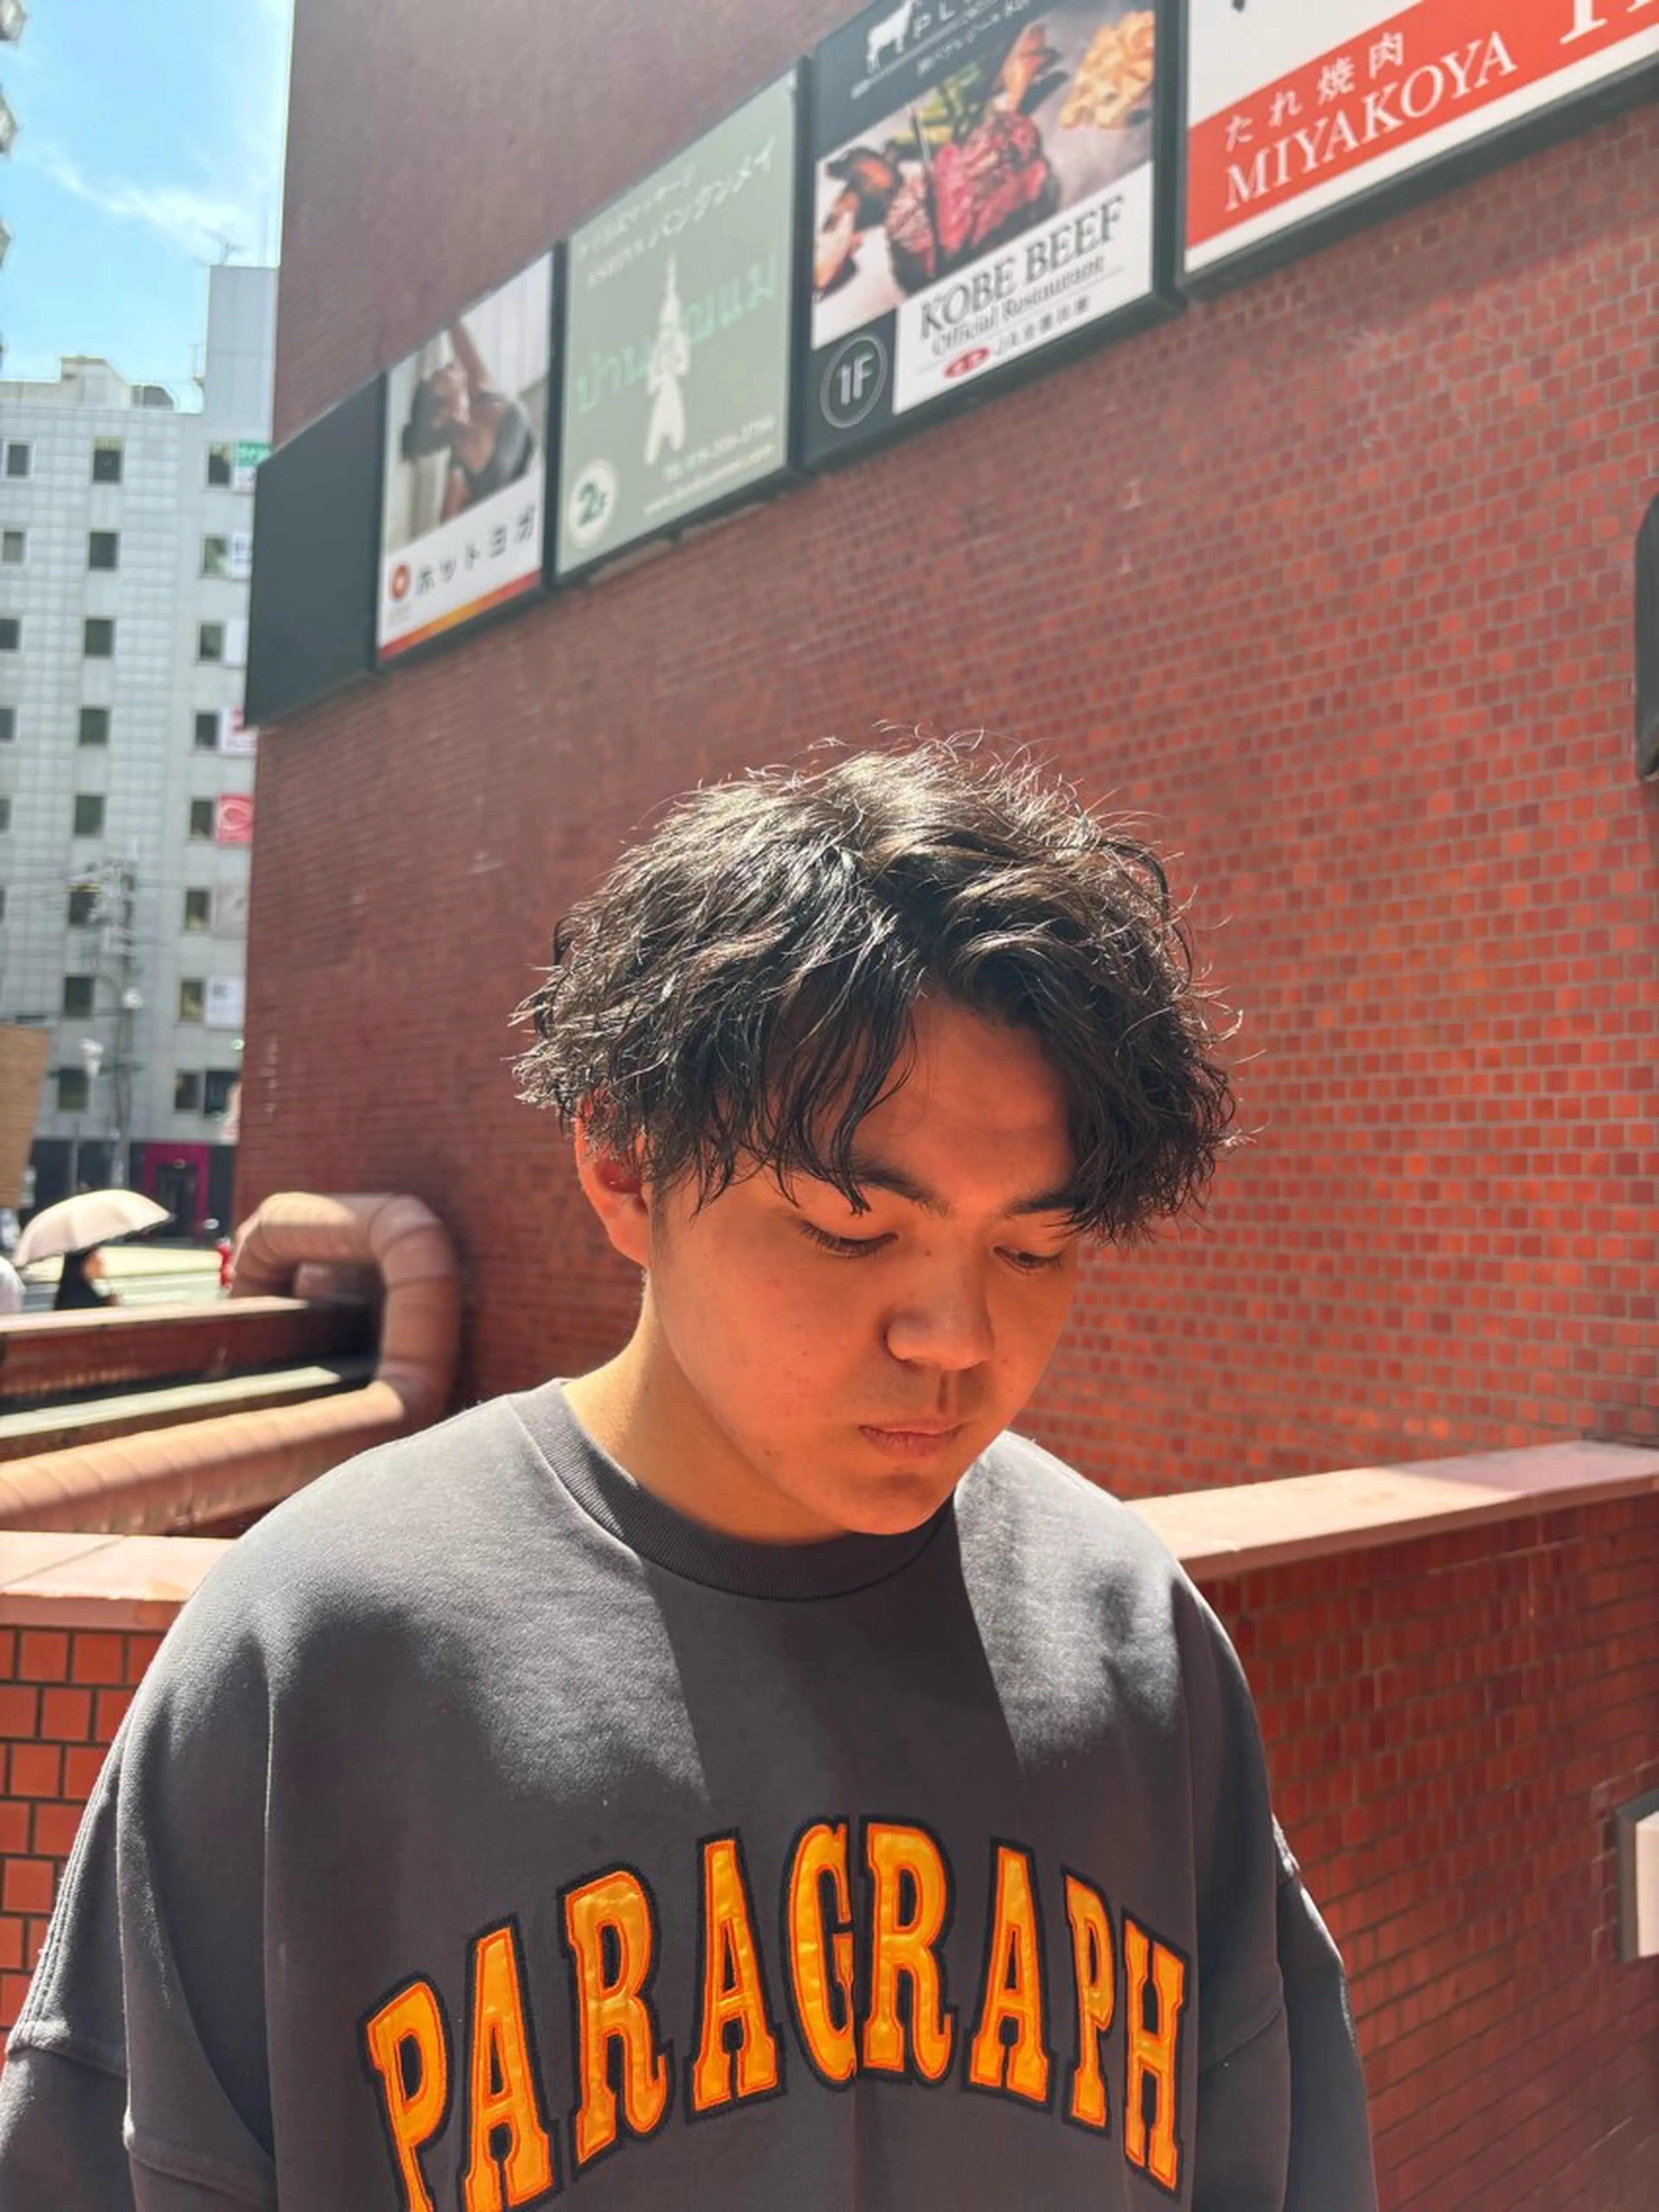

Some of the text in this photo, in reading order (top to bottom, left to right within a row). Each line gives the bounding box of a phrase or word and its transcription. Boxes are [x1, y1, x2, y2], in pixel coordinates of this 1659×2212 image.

[1225, 32, 1404, 152] たれ焼肉
[1225, 30, 1518, 212] MIYAKOYA
[919, 194, 1125, 340] KOBE BEEF
[931, 256, 1104, 356] Official Restaurant
[837, 351, 874, 405] 1F
[416, 504, 536, 595] ホットヨガ
[358, 1815, 1192, 2212] PARAGRAPH
